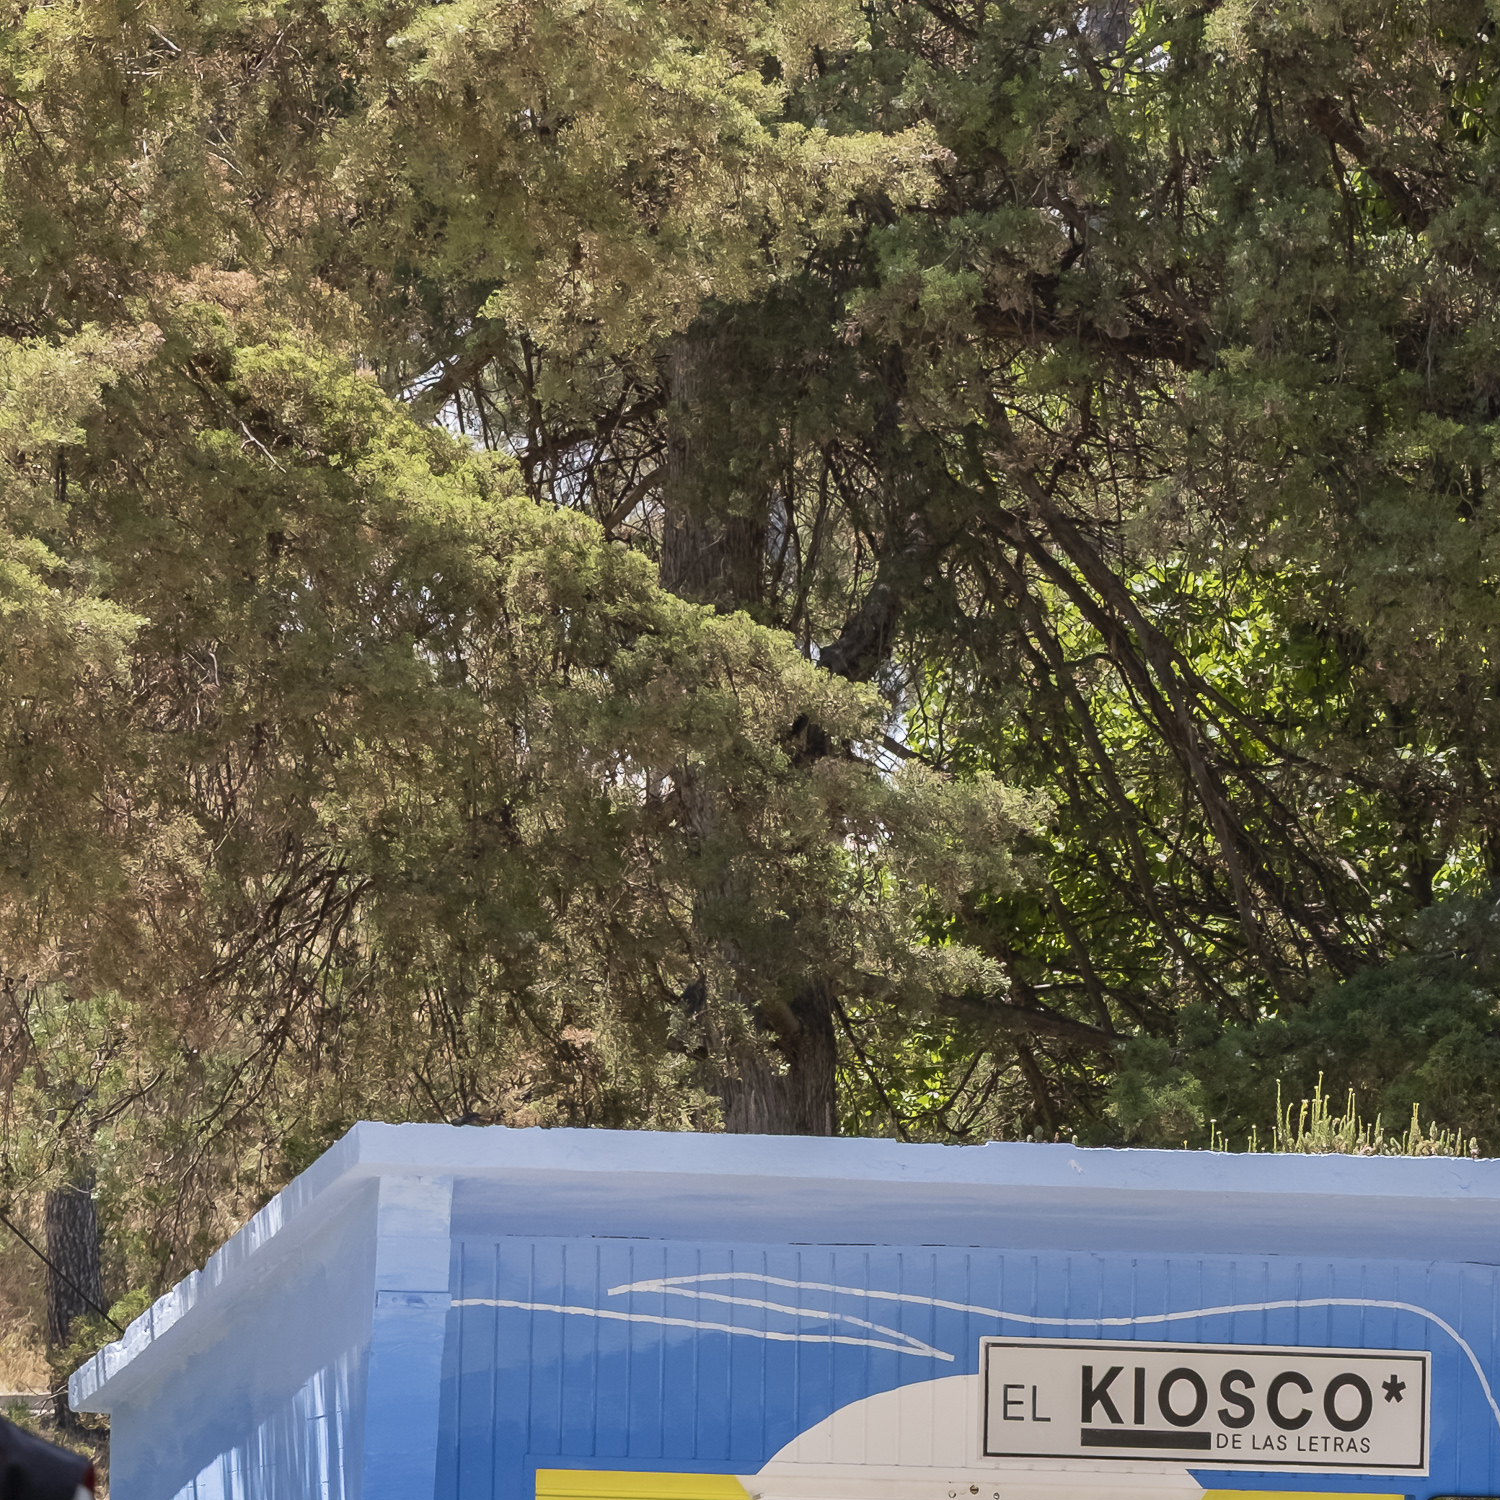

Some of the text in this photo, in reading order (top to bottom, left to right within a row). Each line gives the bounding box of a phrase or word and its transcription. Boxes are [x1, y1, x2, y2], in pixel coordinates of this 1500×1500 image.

[1002, 1384, 1052, 1423] EL
[1216, 1433, 1372, 1454] DE LAS LETRAS
